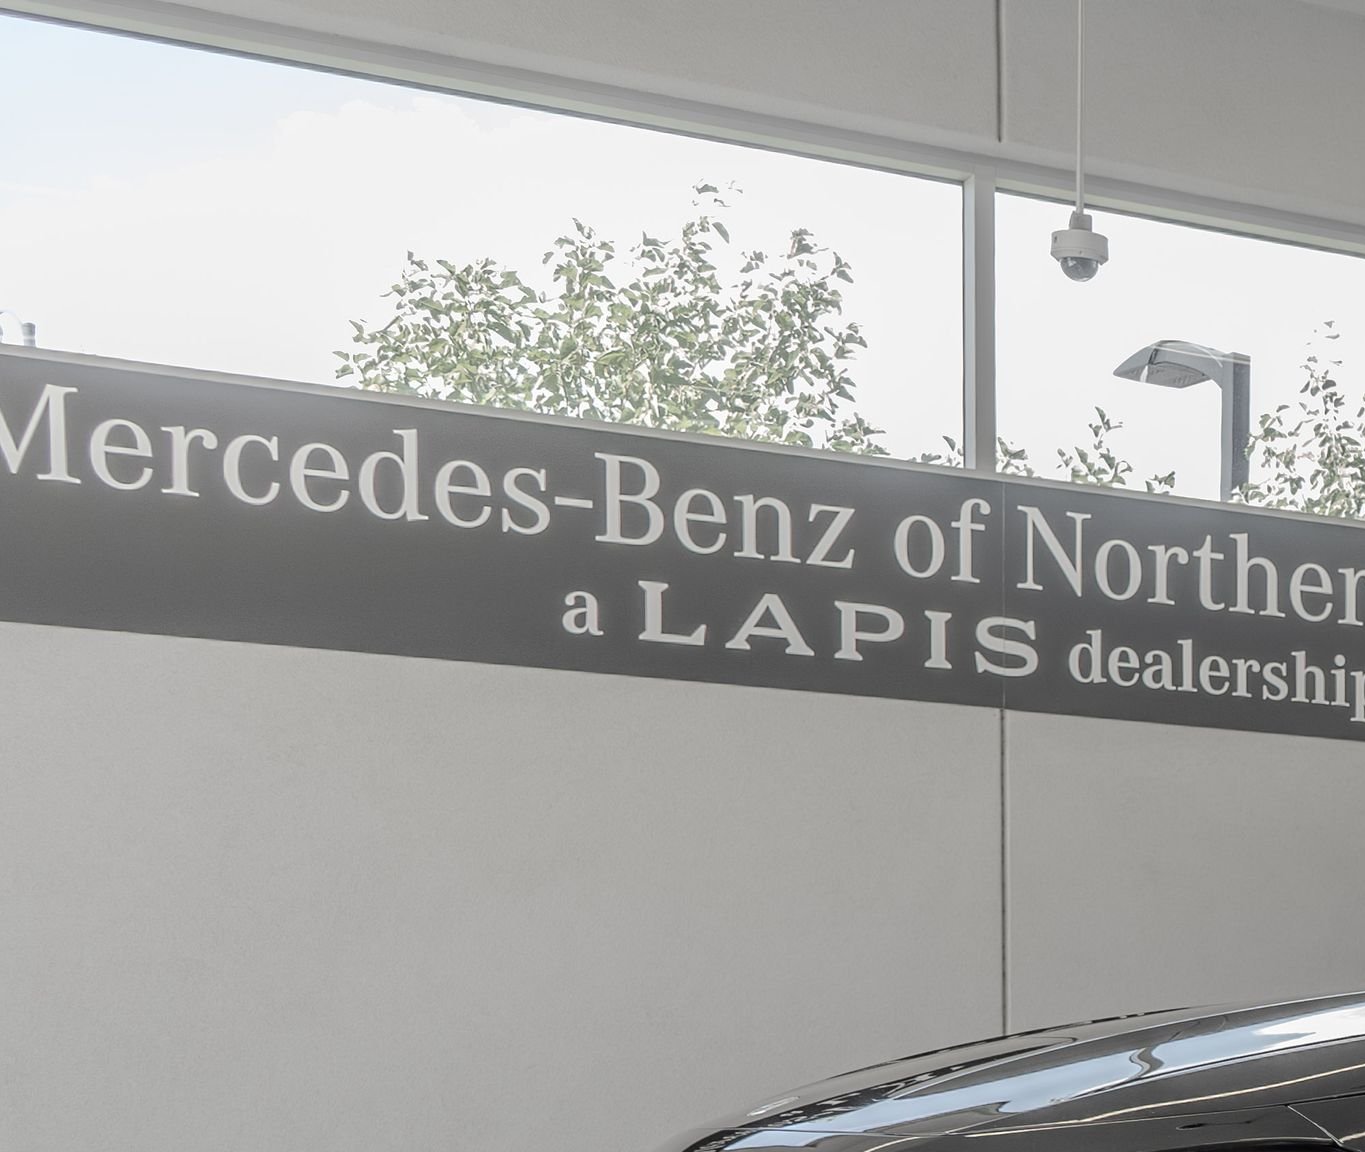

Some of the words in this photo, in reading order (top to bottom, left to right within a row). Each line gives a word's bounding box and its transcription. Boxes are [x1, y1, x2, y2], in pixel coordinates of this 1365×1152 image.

[0, 382, 857, 570] Mercedes-Benz
[892, 497, 993, 585] of
[561, 589, 605, 637] a
[636, 579, 1040, 678] LAPIS
